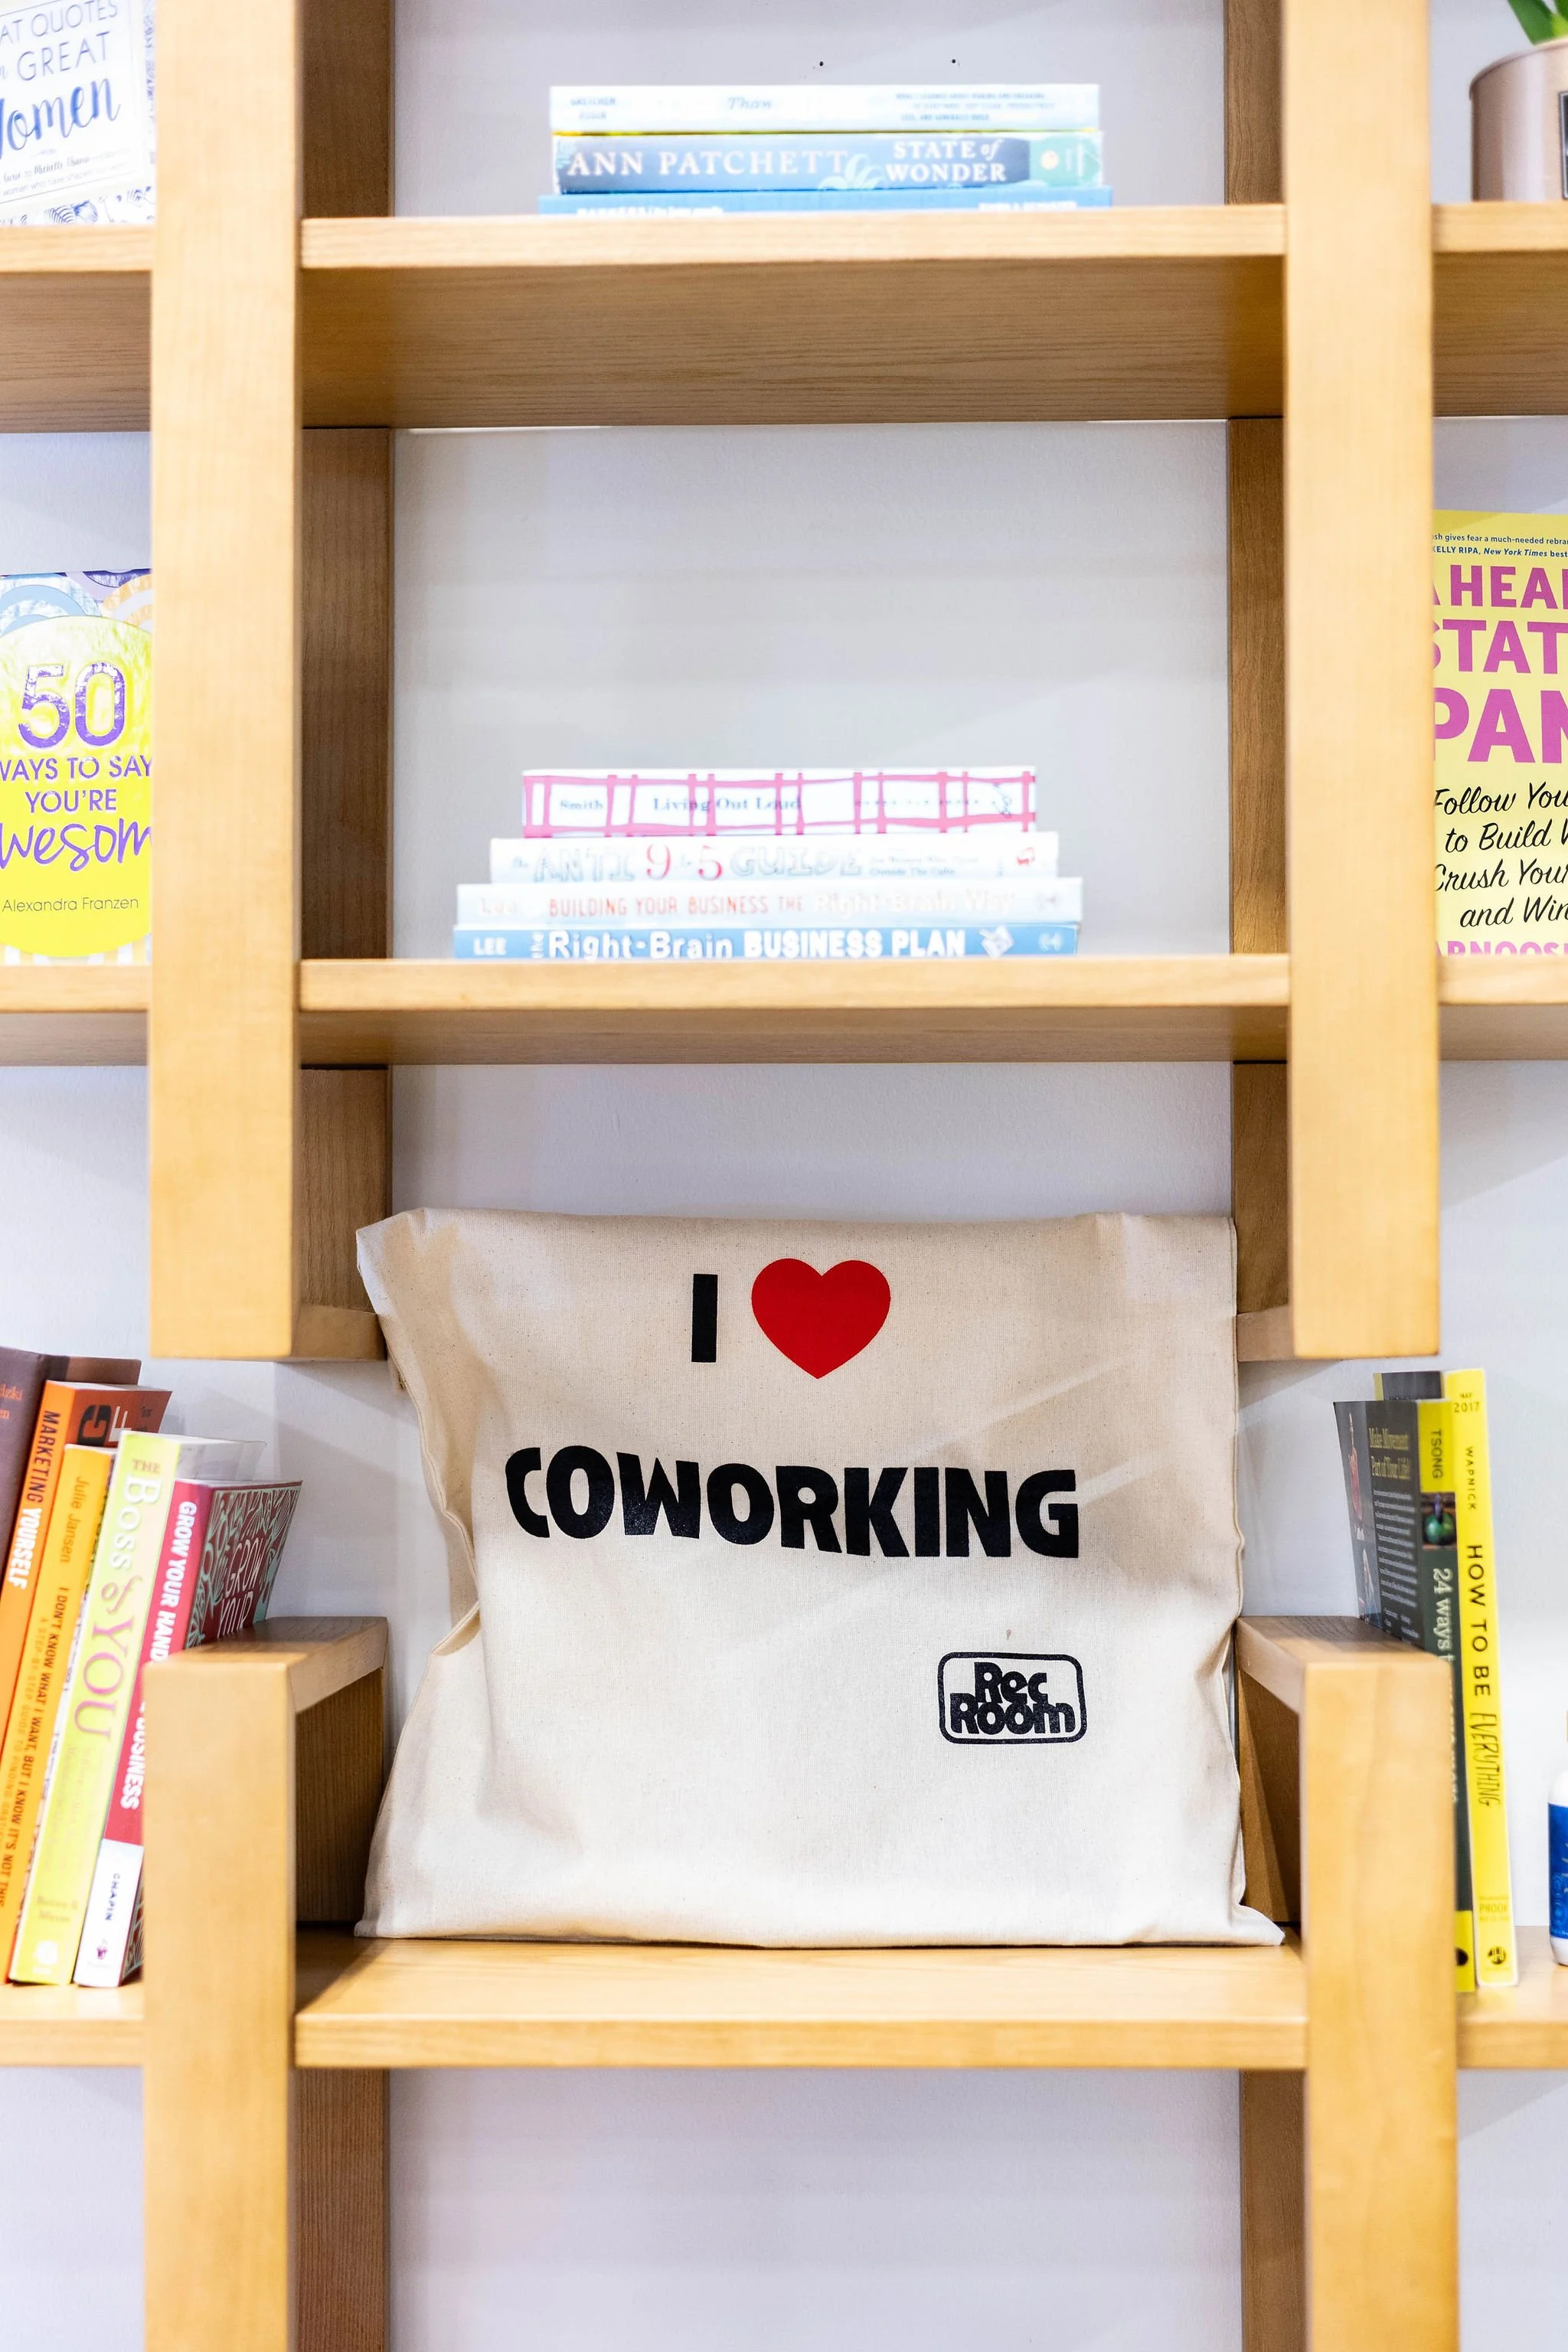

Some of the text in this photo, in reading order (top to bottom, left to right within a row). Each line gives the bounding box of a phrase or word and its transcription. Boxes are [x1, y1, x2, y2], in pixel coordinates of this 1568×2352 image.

[31, 0, 118, 37] QUOTES
[17, 31, 110, 81] GREAT
[0, 78, 121, 160] omen
[727, 96, 773, 110] Than
[567, 149, 849, 176] ANN PATCHETT
[893, 138, 1004, 162] STATE of
[886, 162, 1007, 182] WONDER
[1445, 534, 1465, 543] gives
[1491, 535, 1544, 544] much-needed
[1459, 547, 1481, 555] RIPA,
[1450, 564, 1568, 609] HEA
[18, 662, 126, 748] 50
[67, 756, 100, 779] TO
[109, 755, 151, 778] SAY
[24, 789, 117, 814] YOU'RE
[560, 799, 604, 811] Smith
[654, 797, 801, 814] Living Out Loud
[1433, 786, 1517, 815] Follow
[1445, 828, 1469, 853] to
[1478, 818, 1553, 851] Build
[532, 846, 636, 883] ANTI
[645, 844, 671, 880] 9
[698, 844, 723, 881] 5
[1433, 858, 1510, 892] Crush
[2, 897, 139, 913] Alexandra Franzen
[549, 897, 628, 916] BUILDING
[635, 896, 678, 914] YOUR
[688, 895, 768, 915] BUSINESS
[777, 895, 805, 913] THE
[1459, 897, 1515, 928] and
[472, 936, 507, 956] LEE
[547, 929, 734, 962] Right-Brain
[743, 928, 883, 959] BUSINESS
[891, 928, 965, 958] PLAN
[691, 1273, 718, 1363] I
[1454, 1402, 1481, 1413] 2017
[132, 1458, 161, 1474] THE
[1429, 1429, 1444, 1480] TSONG
[1465, 1446, 1477, 1511] WAPNICK
[8, 1410, 60, 1590] MARKETING YOURSELF
[505, 1445, 1080, 1559] COWORKING
[60, 1475, 90, 1563] Julie Jansen
[109, 1474, 162, 1570] Boss
[172, 1500, 198, 1557] GROW
[160, 1555, 188, 1608] YOUR
[225, 1537, 266, 1598] GROW
[1432, 1567, 1452, 1594] 24
[100, 1574, 144, 1614] of
[51, 1594, 69, 1631] DON'T
[1432, 1598, 1452, 1650] ways
[43, 1633, 59, 1669] KNOW
[36, 1672, 51, 1707] WHAT
[74, 1616, 135, 1740] YOU
[974, 1661, 1049, 1704] Rec
[1467, 1544, 1502, 1807] HOW TO BE EVERYTHING
[949, 1693, 1076, 1736] Room
[23, 1717, 41, 1751] WANT,
[21, 1754, 34, 1779] BUT
[11, 1788, 28, 1824] KNOW
[5, 1828, 20, 1851] IT'S
[1, 1854, 14, 1876] NOT
[104, 1873, 121, 1922] CHAPIN
